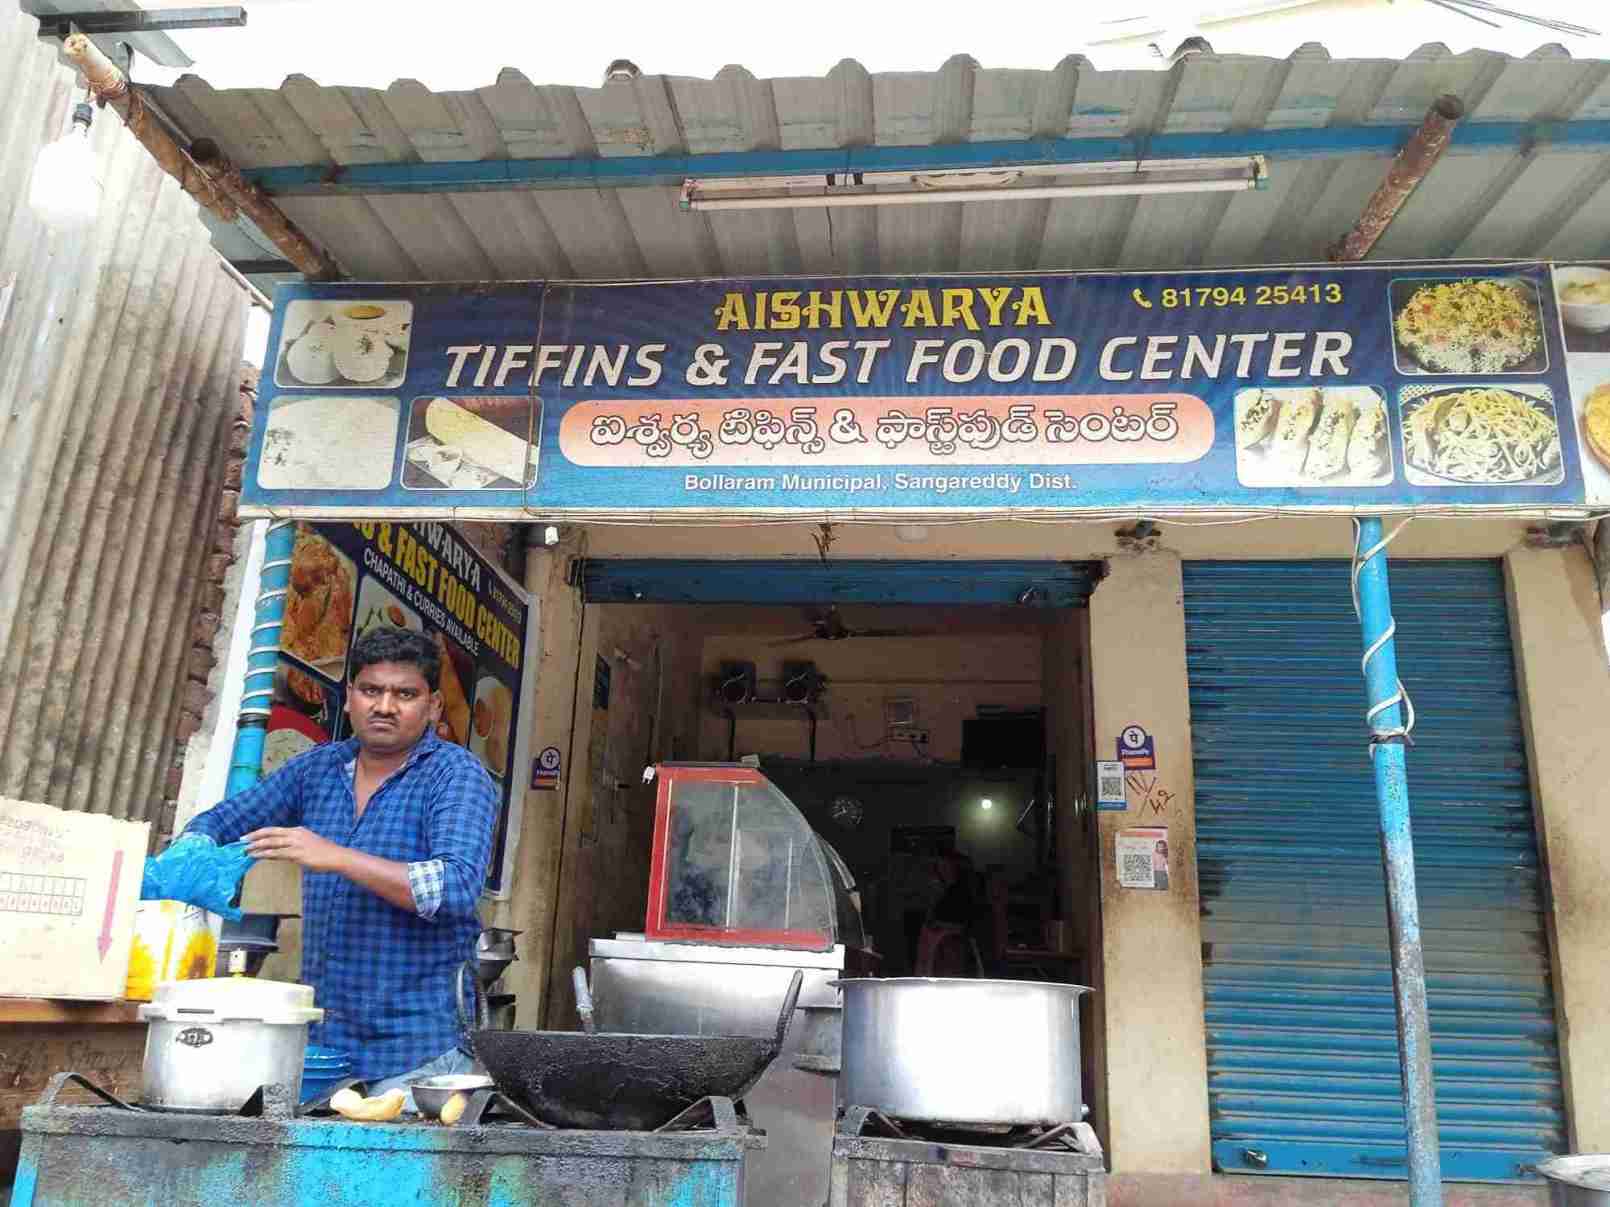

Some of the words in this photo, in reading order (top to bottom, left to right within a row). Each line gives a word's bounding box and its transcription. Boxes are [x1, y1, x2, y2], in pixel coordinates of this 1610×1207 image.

[714, 287, 1053, 331] AISHWARYA
[1161, 287, 1247, 308] 81794
[1255, 283, 1342, 306] 25413
[445, 344, 667, 388] TIFFINS
[685, 342, 731, 387] &
[743, 338, 892, 385] FAST
[905, 337, 1078, 384] FOOD
[1098, 331, 1353, 381] CENTER
[828, 408, 868, 443] &
[684, 474, 774, 490] Bollaram
[895, 473, 1021, 493] Sangareddy
[1030, 473, 1077, 489] Dist.
[363, 547, 407, 595] CHAPATHI
[395, 527, 438, 594] FAST
[439, 566, 477, 630] FOOD
[477, 603, 521, 670] CENTER
